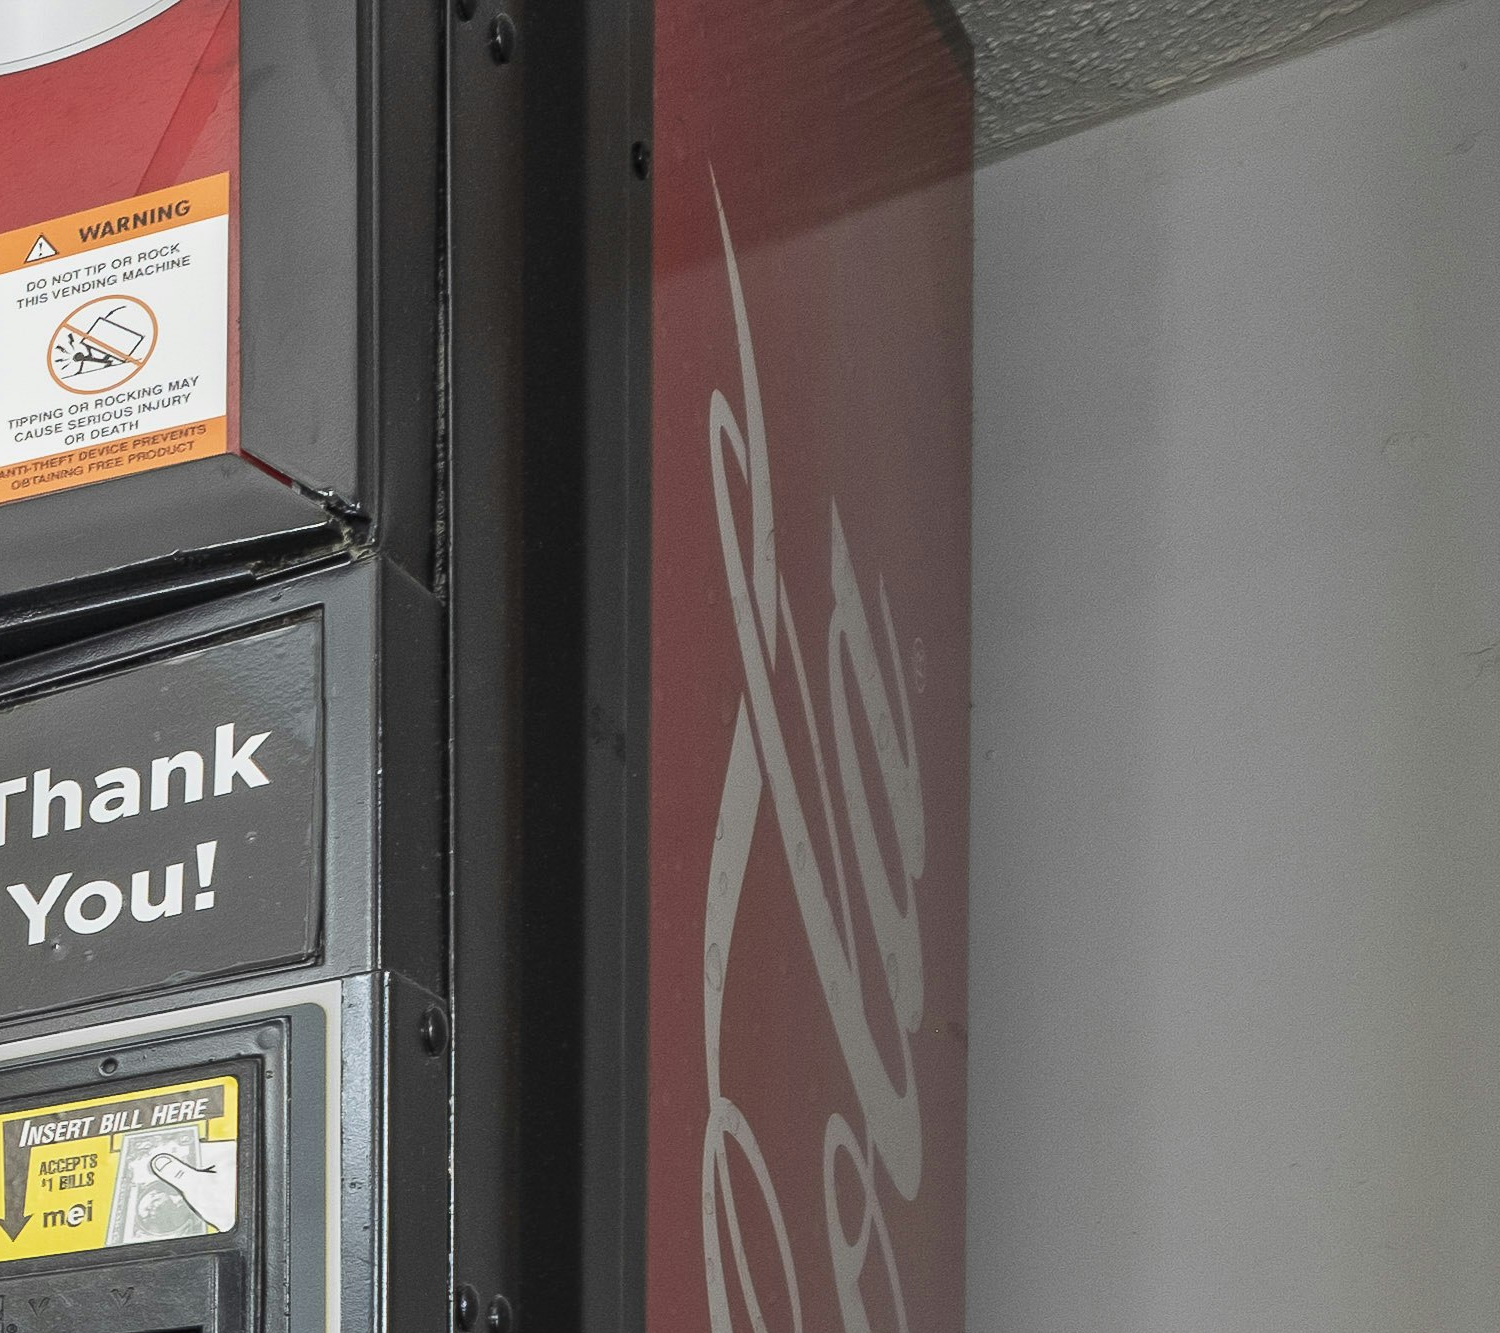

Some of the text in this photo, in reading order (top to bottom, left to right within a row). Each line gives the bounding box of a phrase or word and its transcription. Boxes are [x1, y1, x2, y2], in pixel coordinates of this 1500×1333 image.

[79, 199, 191, 243] WARNING
[16, 255, 191, 310] THIS VENDING MACHINE
[27, 242, 181, 293] DO NOT TIP OR ROCK
[7, 375, 200, 430] TIPPING OR ROCKING MAY
[14, 392, 192, 443] CAUSE SERIOUS INJURY
[64, 420, 139, 447] OR DEATH
[78, 441, 128, 462] DEVICE
[133, 424, 207, 447] PREVENTS
[10, 440, 196, 491] OBTAINING FREE PRODUCT
[6, 840, 218, 946] You!
[19, 1097, 209, 1149] INSERT BILL HERE
[38, 1153, 98, 1176] ACCEPTS
[41, 1171, 95, 1192] $1 BILLS
[43, 1200, 94, 1229] mei
